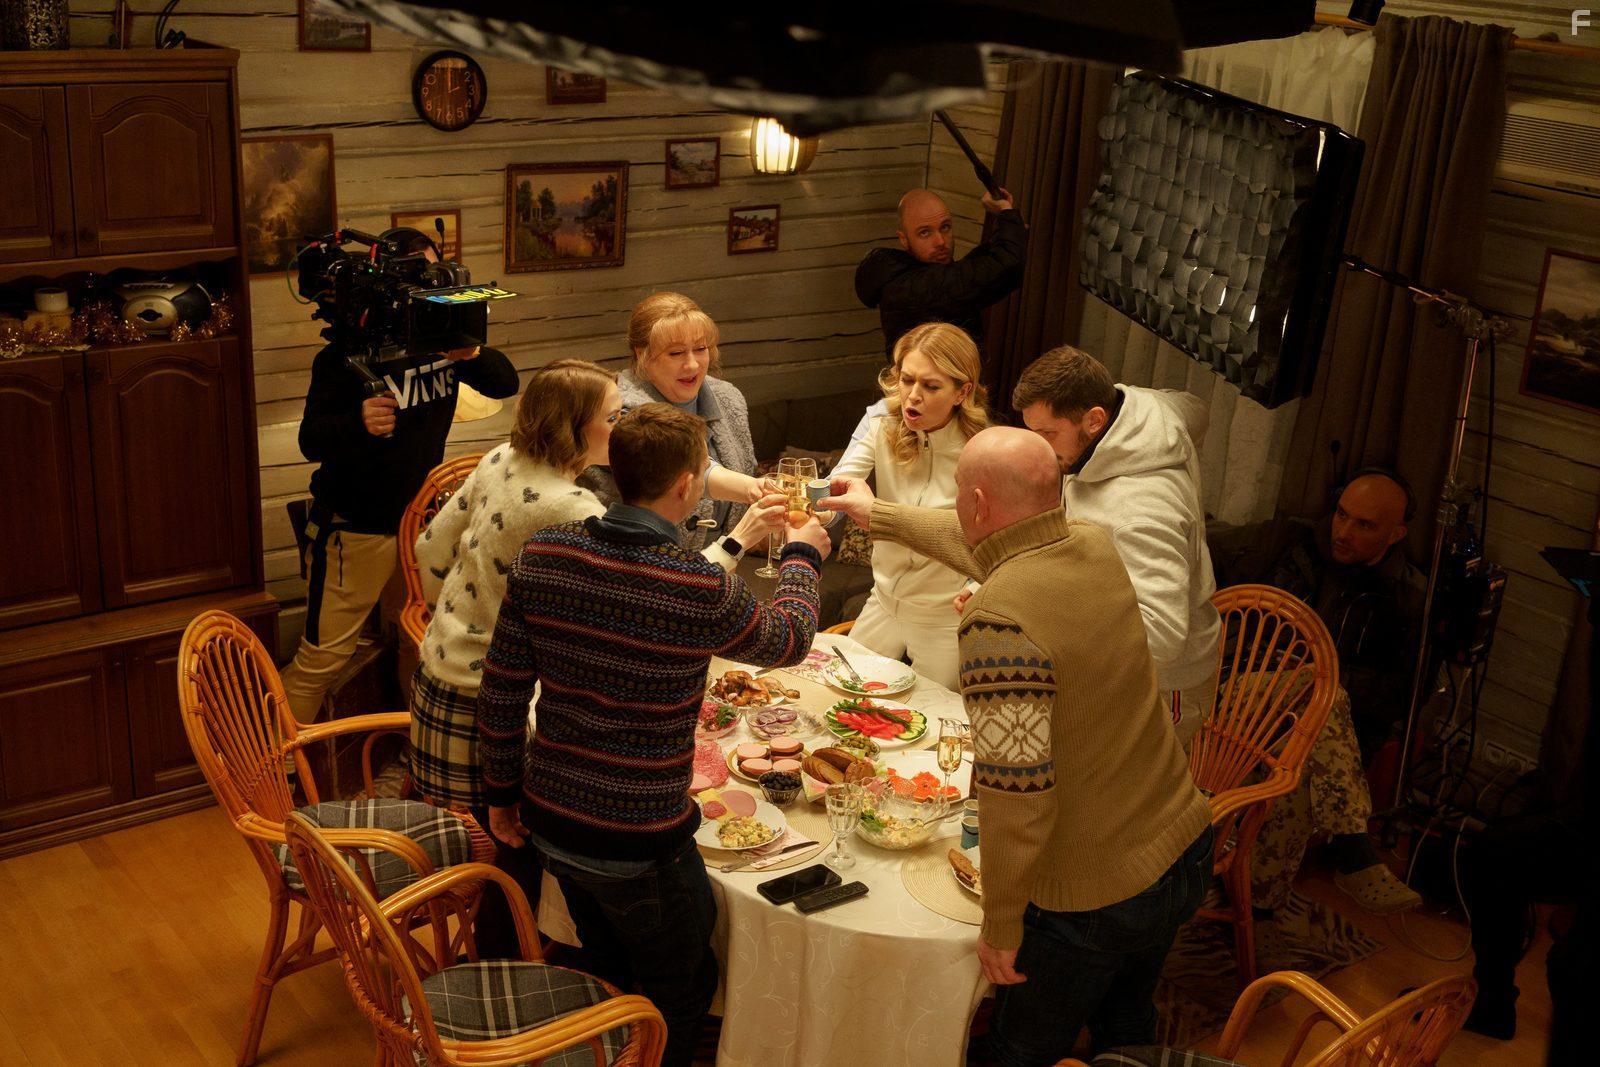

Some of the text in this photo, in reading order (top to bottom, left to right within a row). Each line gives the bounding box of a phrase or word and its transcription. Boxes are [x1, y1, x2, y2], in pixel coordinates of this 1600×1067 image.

[464, 71, 471, 82] 2
[422, 86, 429, 97] 9
[468, 85, 475, 96] 3
[425, 100, 432, 111] 8
[436, 108, 442, 119] 7
[446, 110, 453, 121] 6
[457, 107, 464, 118] 5
[383, 359, 454, 410] VANS
